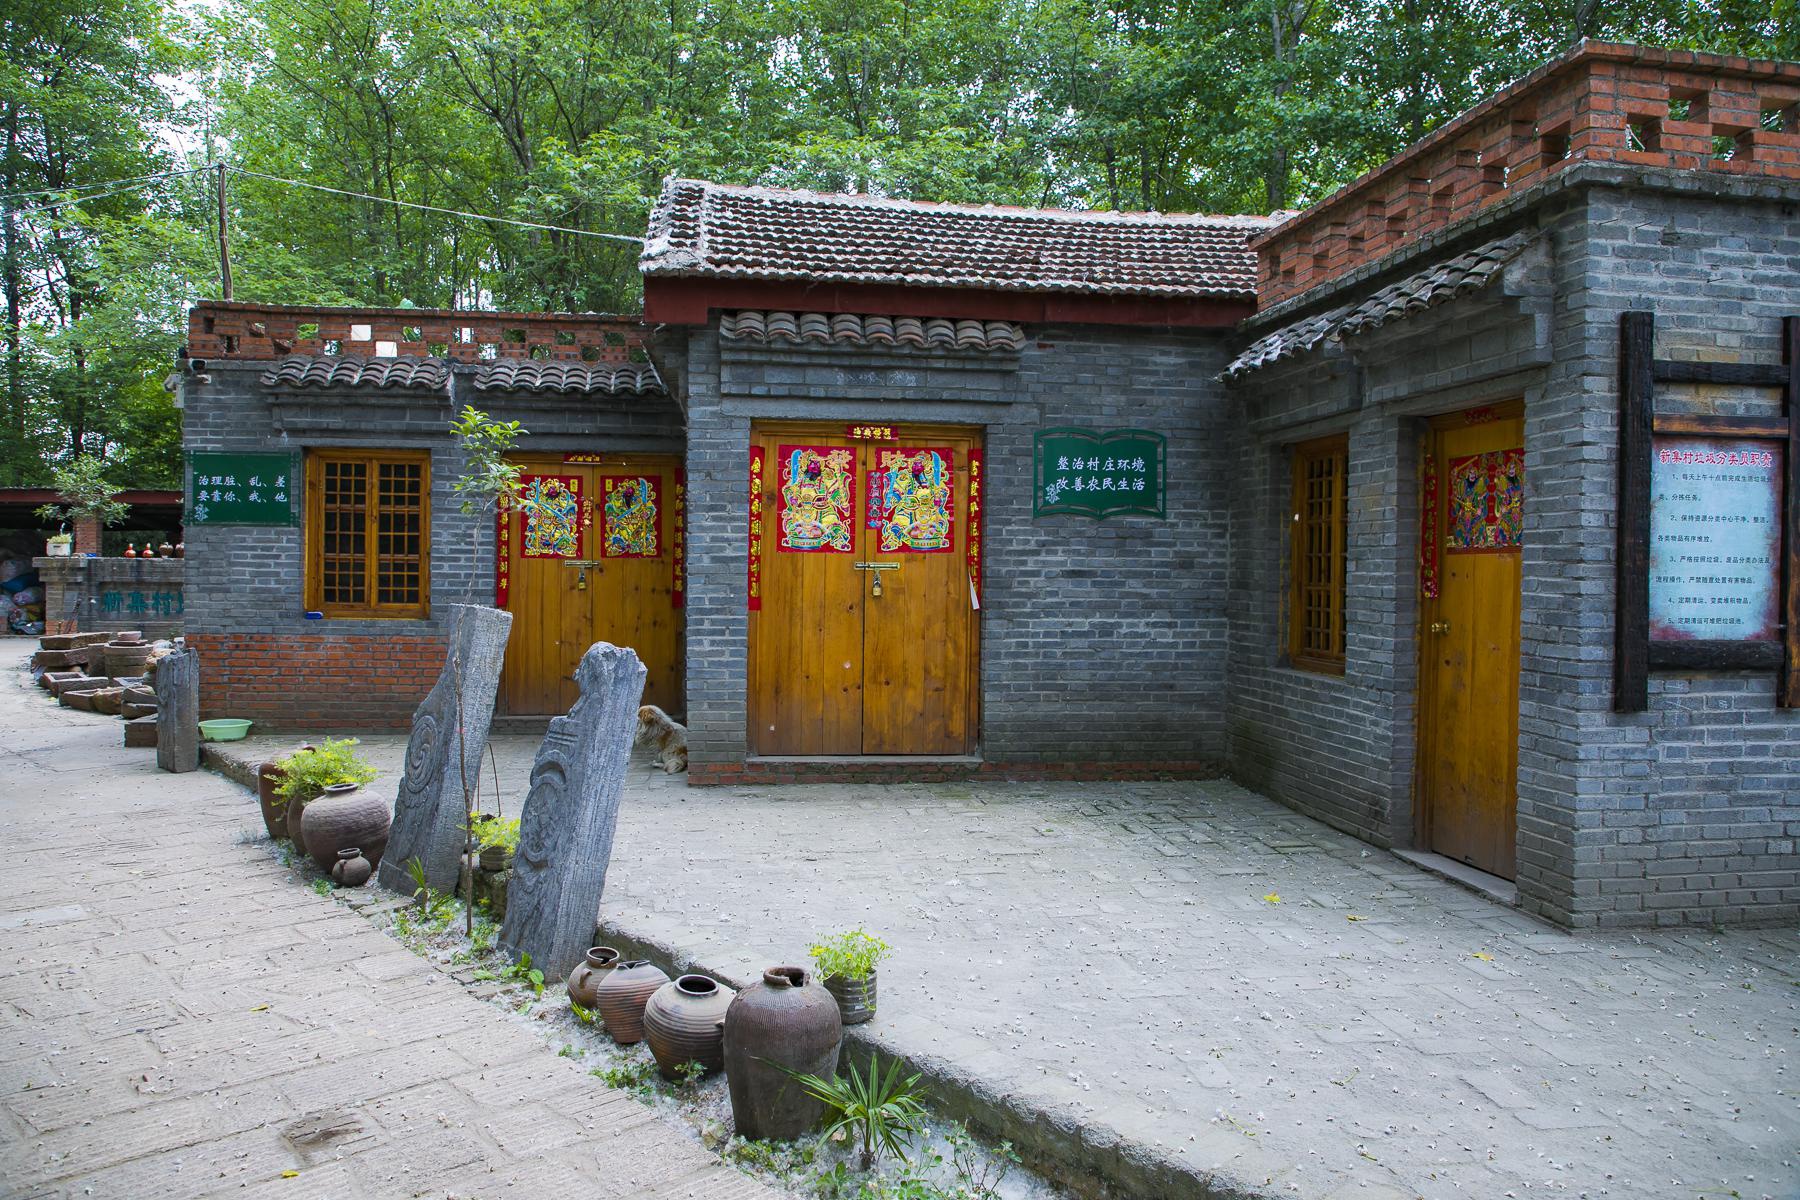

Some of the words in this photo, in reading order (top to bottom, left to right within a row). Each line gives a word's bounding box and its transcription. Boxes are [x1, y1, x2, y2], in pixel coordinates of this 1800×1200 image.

[1056, 456, 1146, 472] 整治村庄环境
[1660, 449, 1773, 467] 新集村垃圾分类员职责
[198, 474, 286, 488] 治理脏、乱、差
[1056, 476, 1146, 491] 改善农民生活
[197, 489, 288, 503] 要靠你、我、他
